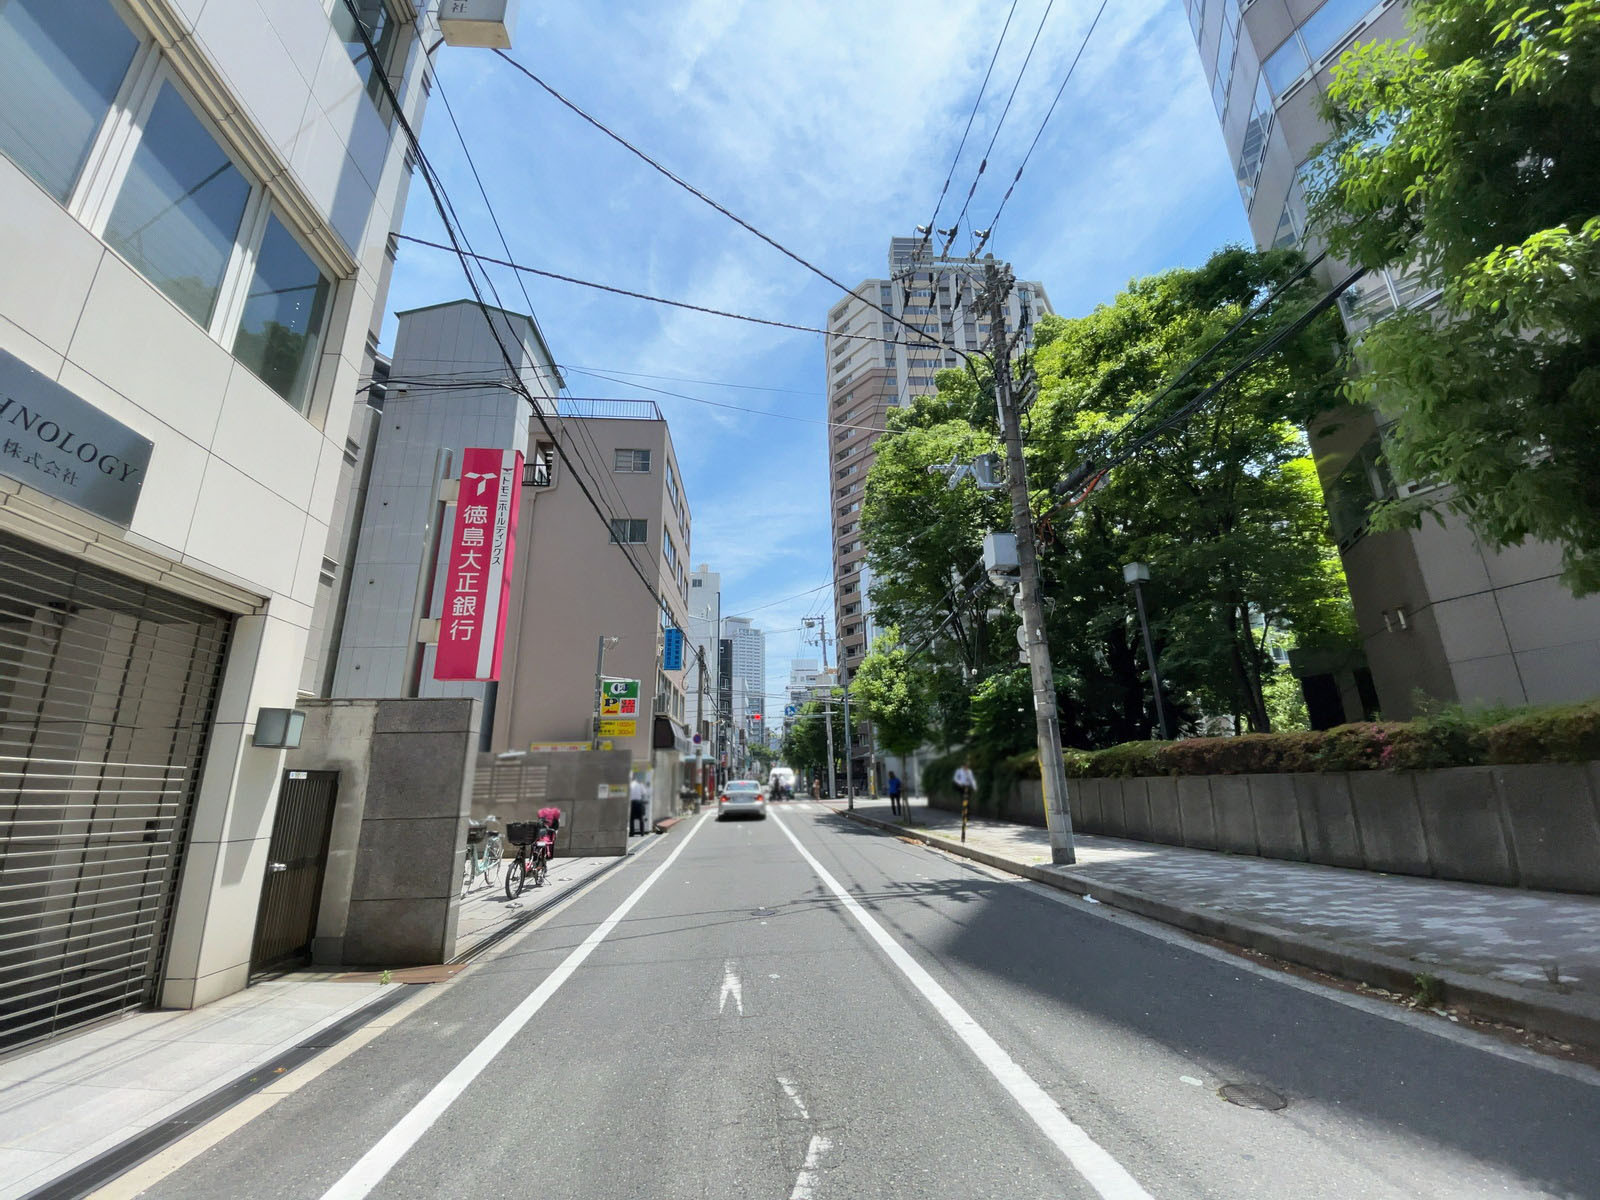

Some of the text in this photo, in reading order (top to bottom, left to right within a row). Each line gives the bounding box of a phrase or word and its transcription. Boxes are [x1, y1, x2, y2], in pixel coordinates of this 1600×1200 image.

[3, 438, 81, 488] 株式会社
[492, 476, 509, 565] トモニホールディングス
[450, 504, 488, 642] 徳島大正銀行
